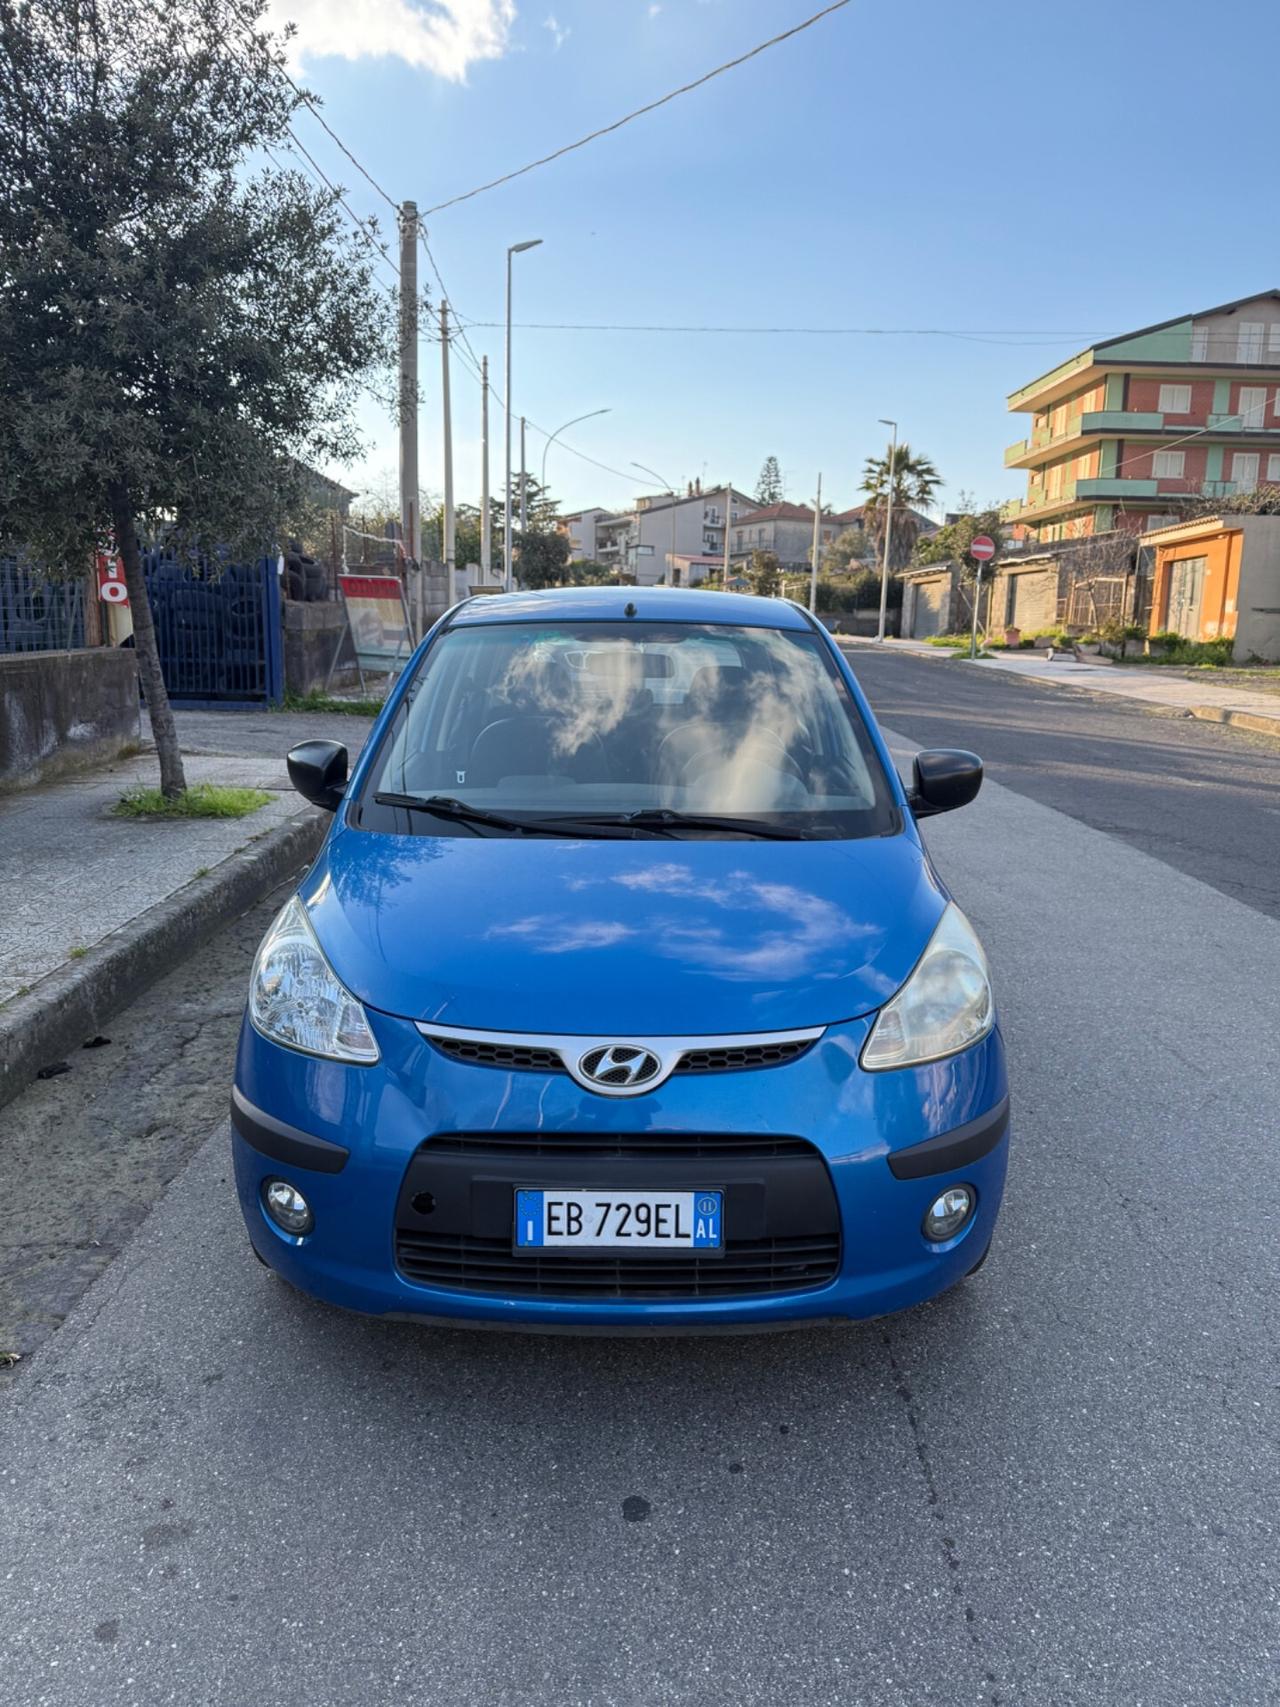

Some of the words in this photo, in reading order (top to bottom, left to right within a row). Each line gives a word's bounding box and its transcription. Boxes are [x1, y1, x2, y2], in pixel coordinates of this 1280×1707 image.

[527, 1220, 534, 1241] I
[546, 1201, 584, 1237] EB
[595, 1203, 692, 1239] 729EL
[696, 1218, 717, 1239] AL
